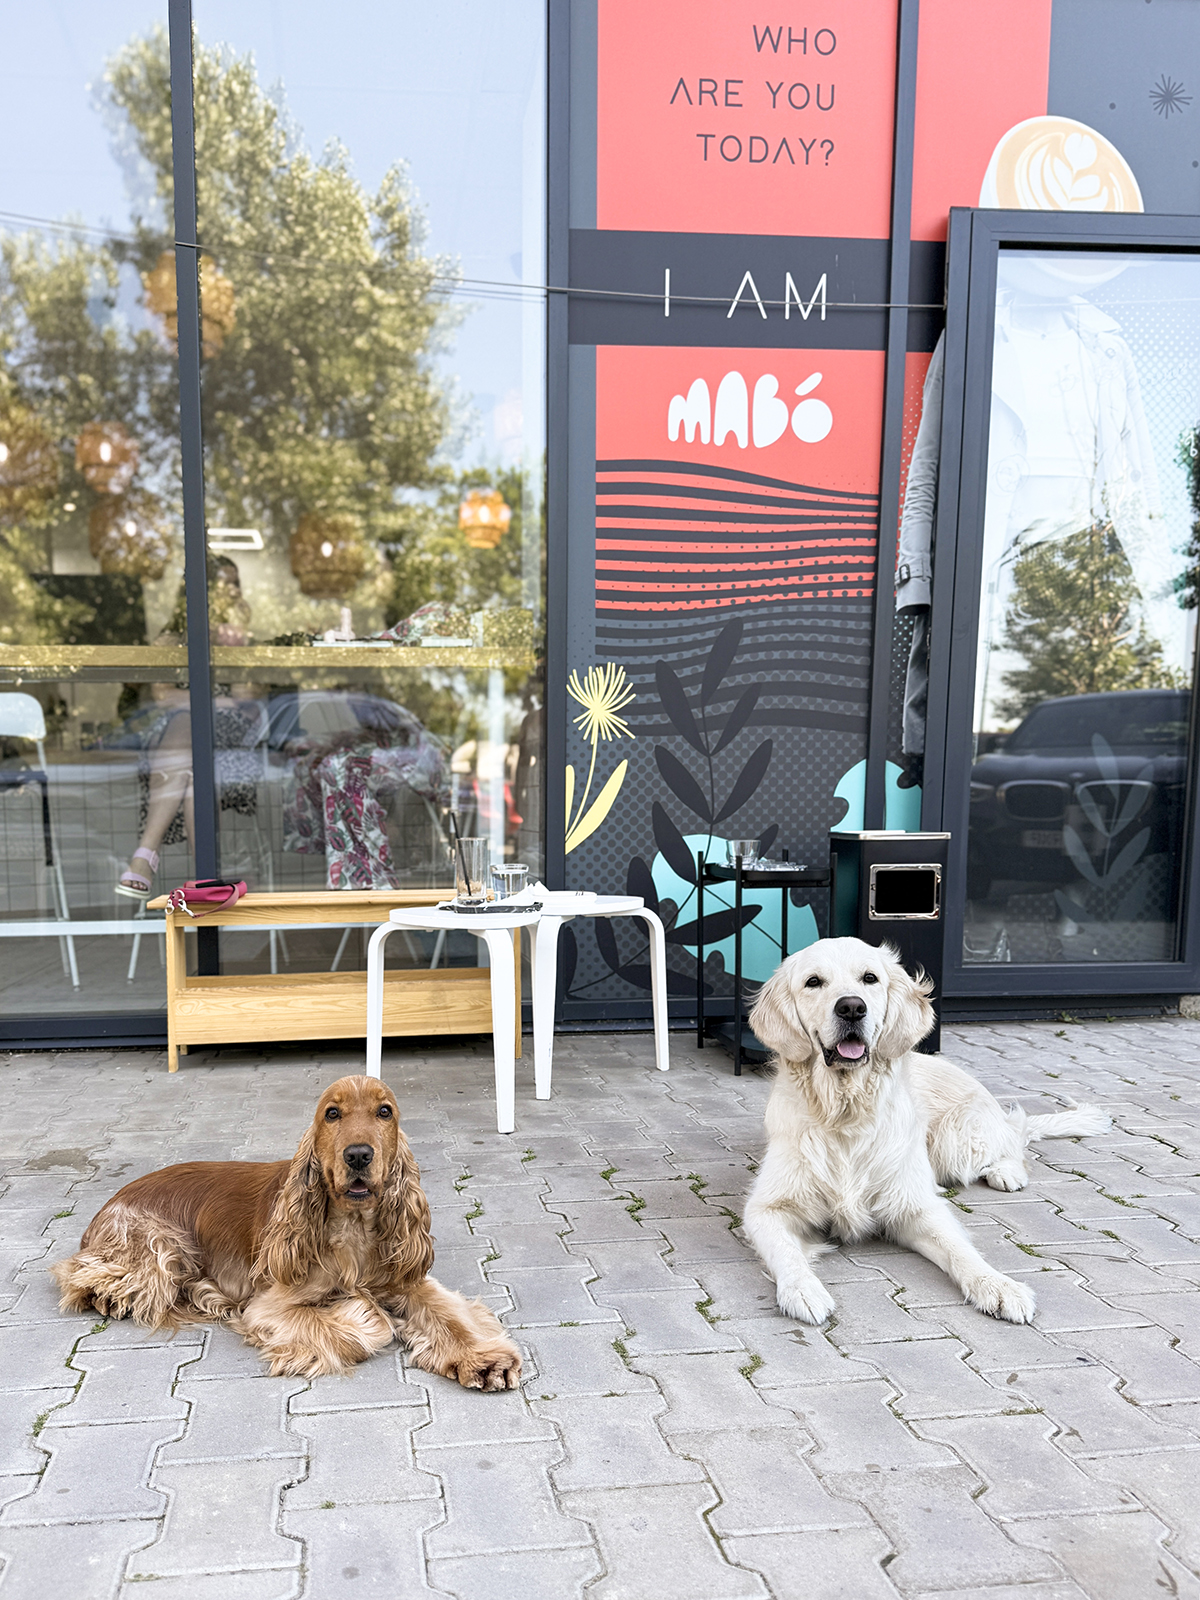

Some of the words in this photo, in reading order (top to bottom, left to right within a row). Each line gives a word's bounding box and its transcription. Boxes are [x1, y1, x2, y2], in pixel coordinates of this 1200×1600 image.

[752, 25, 837, 56] WHO
[669, 77, 744, 108] ARE
[765, 81, 835, 112] YOU
[696, 133, 835, 167] TODAY?
[664, 268, 670, 317] I
[726, 270, 827, 321] AM
